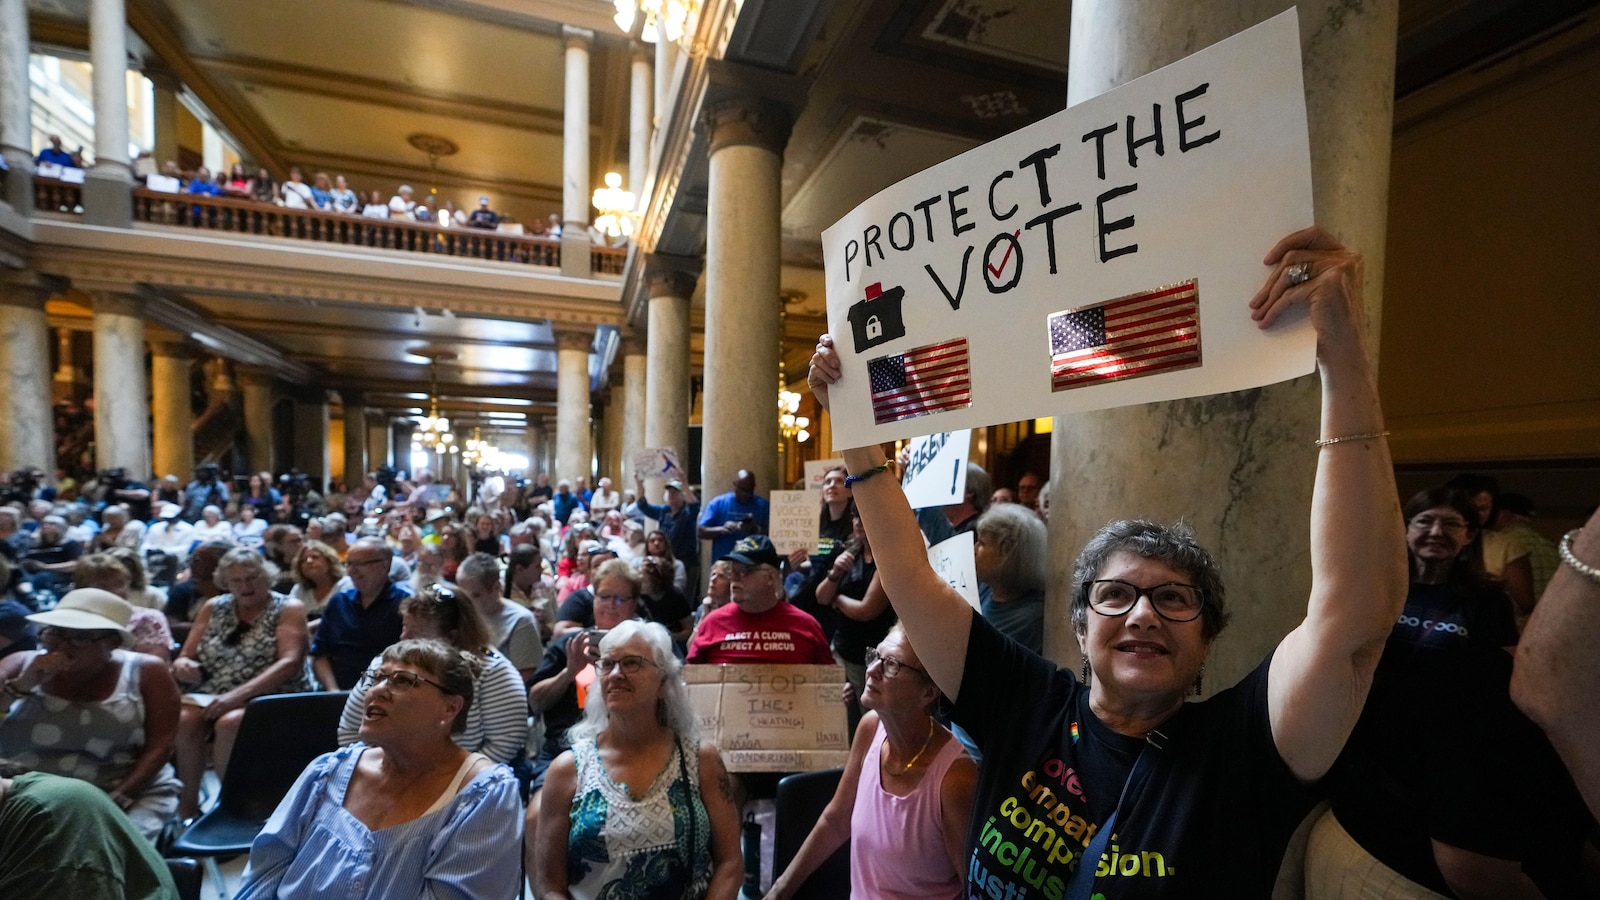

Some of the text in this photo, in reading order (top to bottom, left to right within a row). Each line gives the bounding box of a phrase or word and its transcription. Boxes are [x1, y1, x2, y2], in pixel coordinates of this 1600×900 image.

[844, 83, 1221, 282] PROTECT THE
[925, 183, 1138, 310] VOTE
[775, 505, 811, 517] VOICES
[780, 519, 813, 529] MATTER
[771, 529, 812, 538] LISTEN TO
[1397, 614, 1420, 627] DO
[725, 631, 791, 641] ELECT A CLOWN
[720, 642, 795, 651] EXPECT A CIRCUS
[739, 674, 806, 694] STOP
